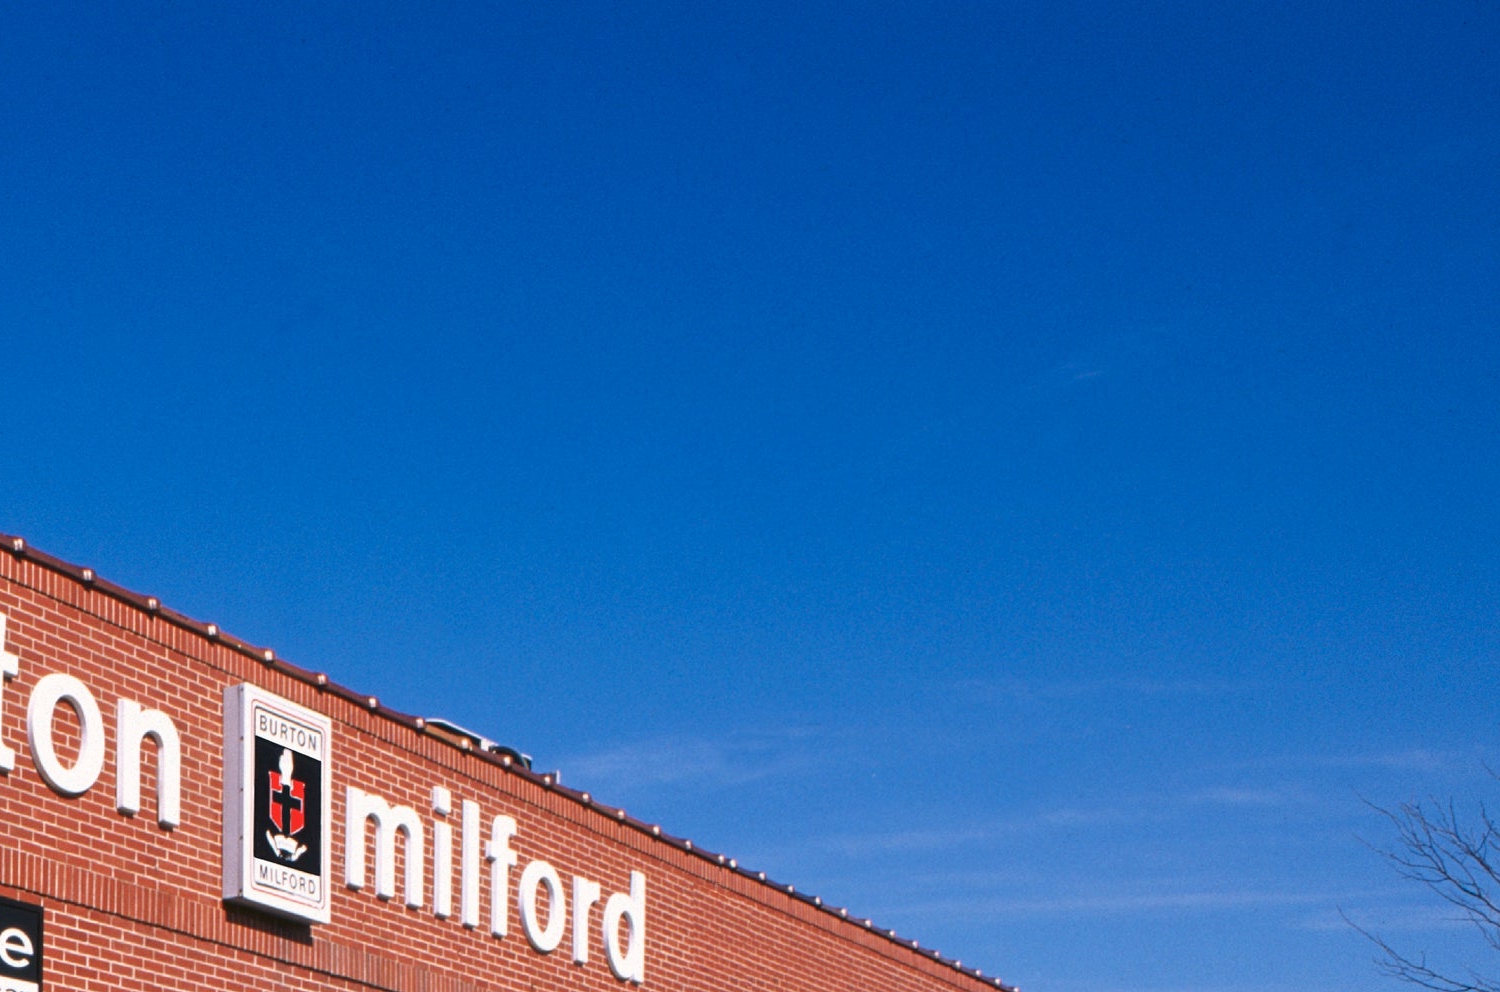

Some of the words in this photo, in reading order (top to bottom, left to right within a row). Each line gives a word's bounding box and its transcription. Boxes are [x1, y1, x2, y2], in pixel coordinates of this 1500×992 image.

[259, 713, 317, 752] BURTON
[259, 863, 316, 896] MILFORD
[345, 786, 646, 985] milford
